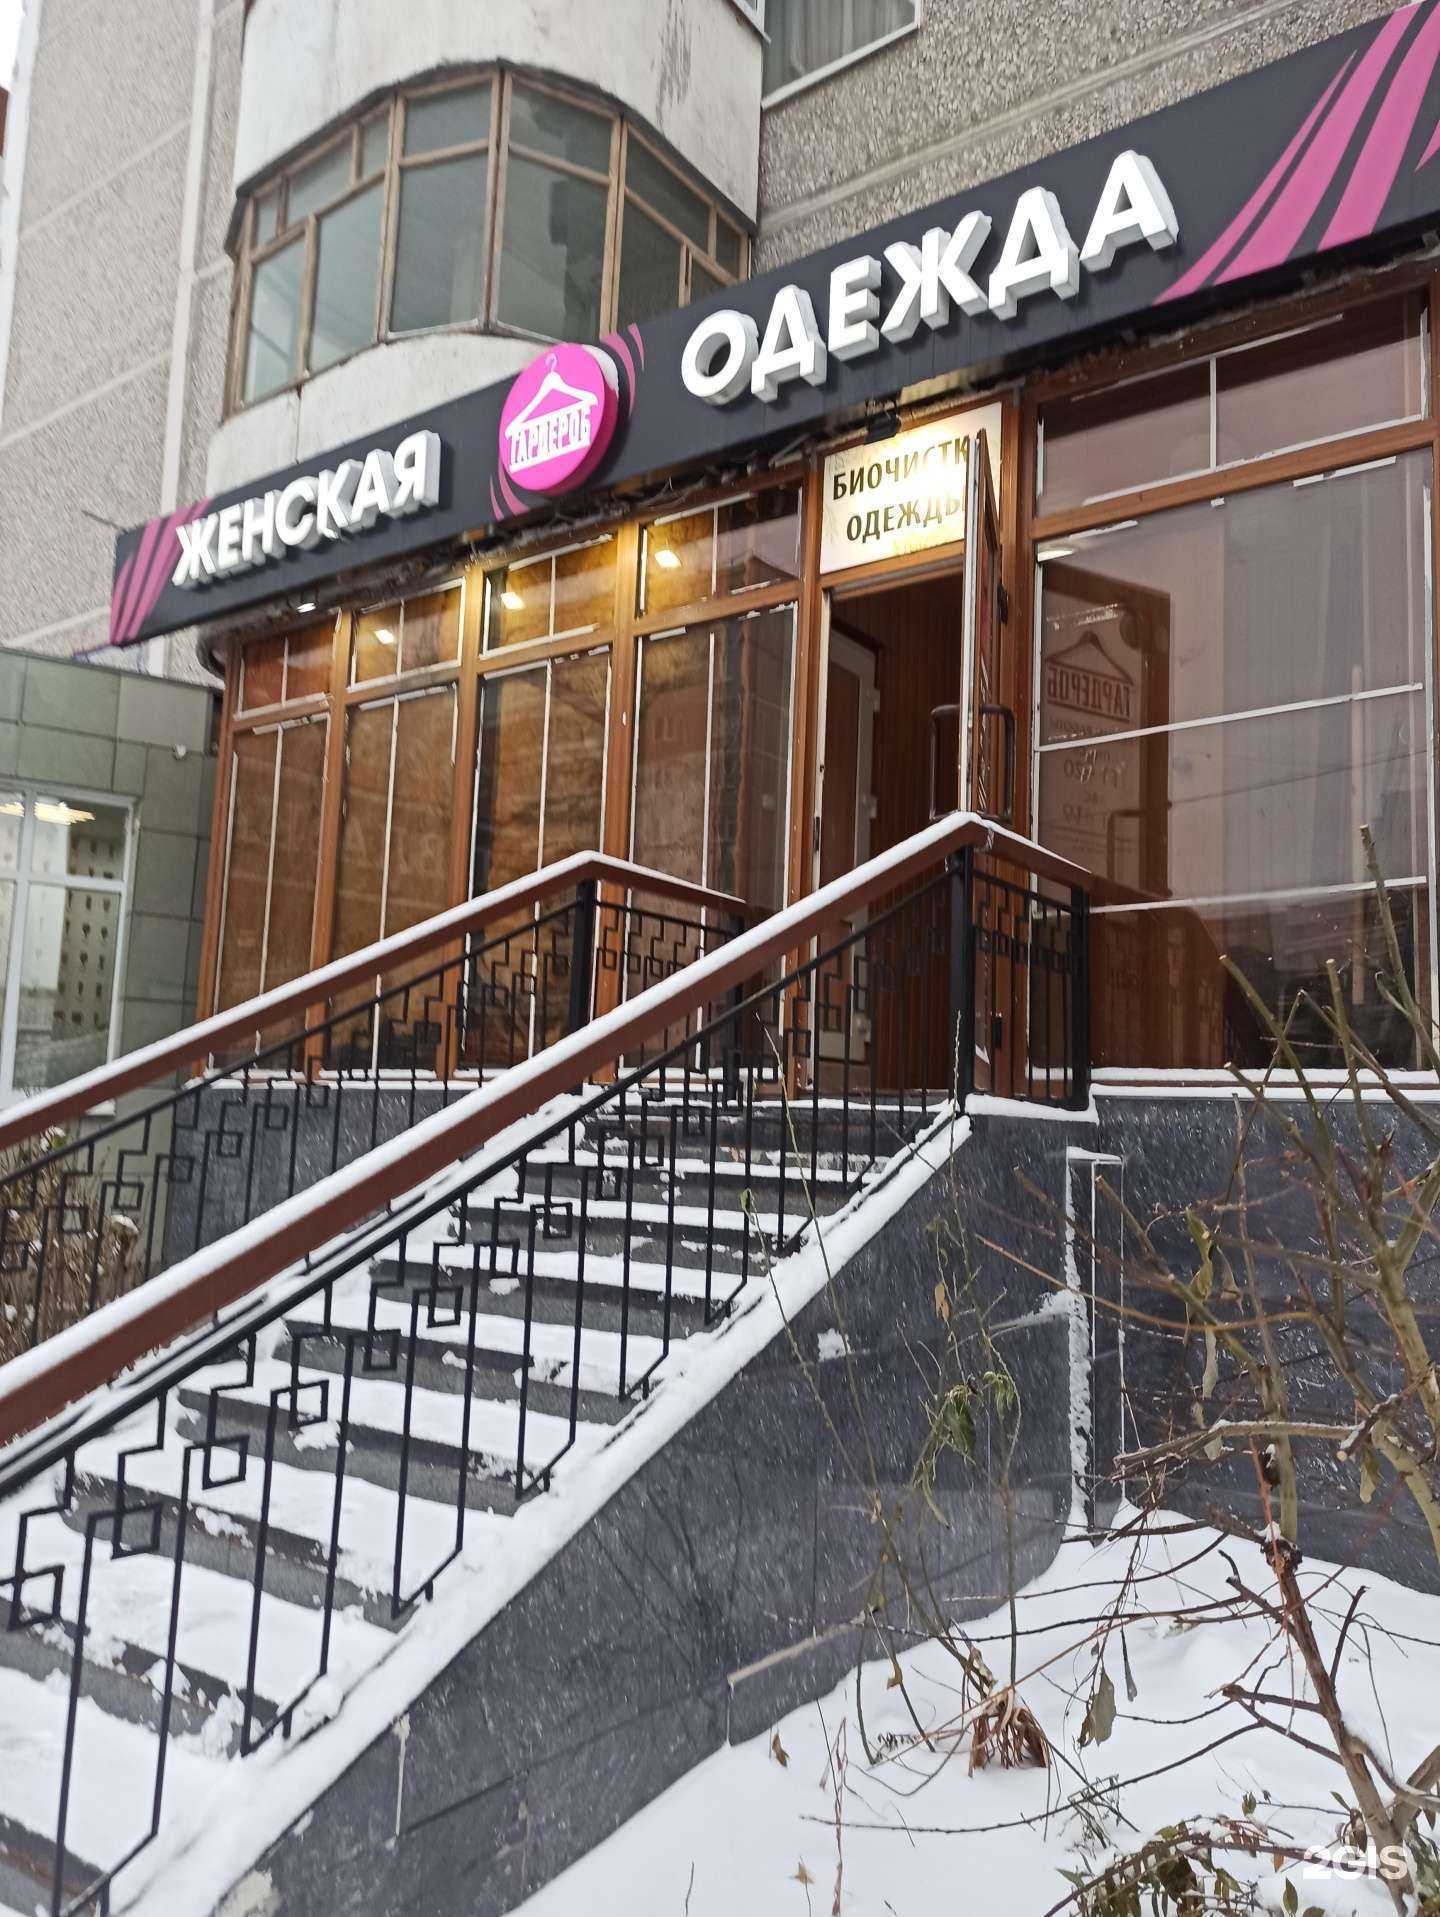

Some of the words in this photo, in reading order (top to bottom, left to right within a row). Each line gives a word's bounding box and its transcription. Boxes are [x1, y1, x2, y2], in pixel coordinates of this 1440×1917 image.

[172, 430, 441, 588] ЖЕНСКАЯ
[681, 149, 1178, 404] ОДЕЖДА
[509, 407, 593, 467] ГАРДЕРОБ
[833, 434, 970, 500] БИОЧИСТК
